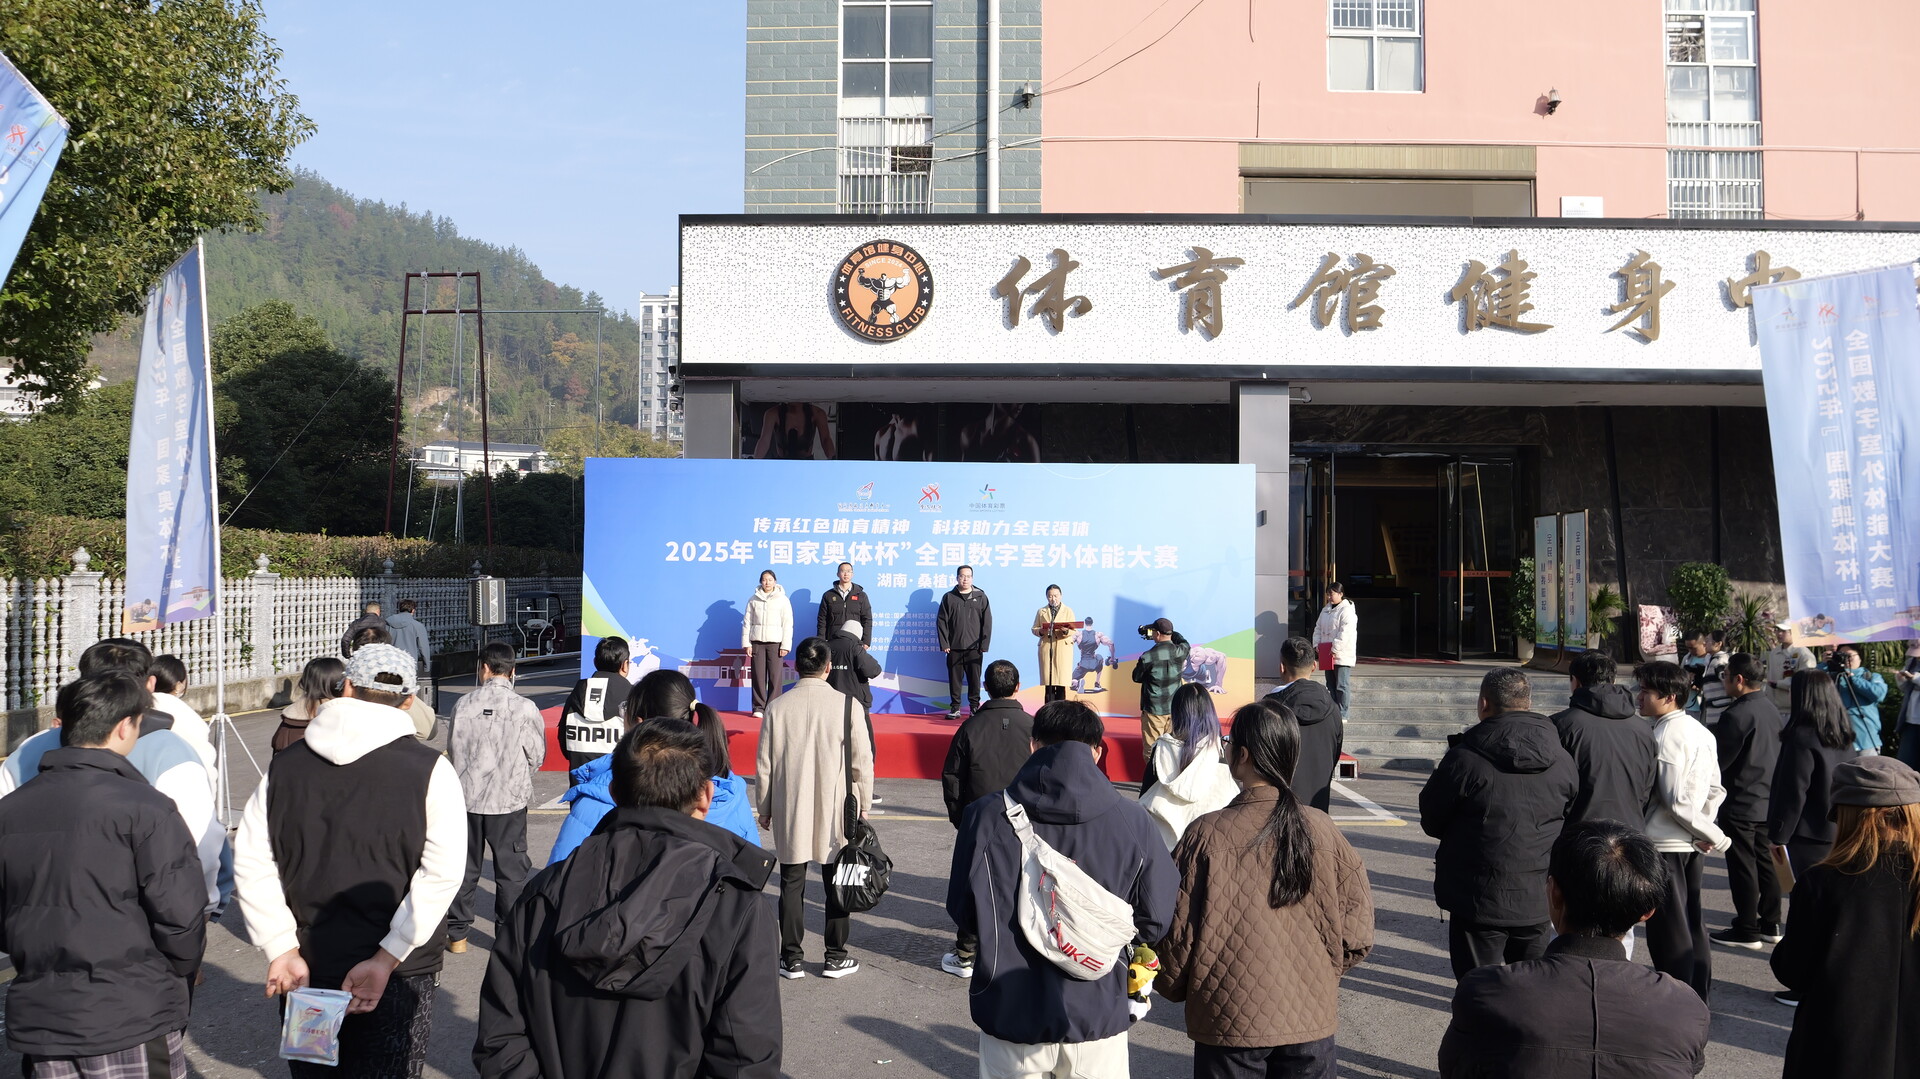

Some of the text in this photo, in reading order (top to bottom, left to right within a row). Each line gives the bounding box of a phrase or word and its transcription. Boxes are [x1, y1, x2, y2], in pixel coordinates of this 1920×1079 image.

[864, 257, 886, 268] SINCE
[999, 247, 1920, 342] 体育馆健身中
[842, 306, 925, 337] FITNESS CLUB
[753, 517, 1090, 537] 传承红色体育精神 科技助力全民强体
[665, 540, 1178, 570] 2025年“国家奥体杯”全国数字室外体能大赛
[832, 863, 871, 886] NIKE
